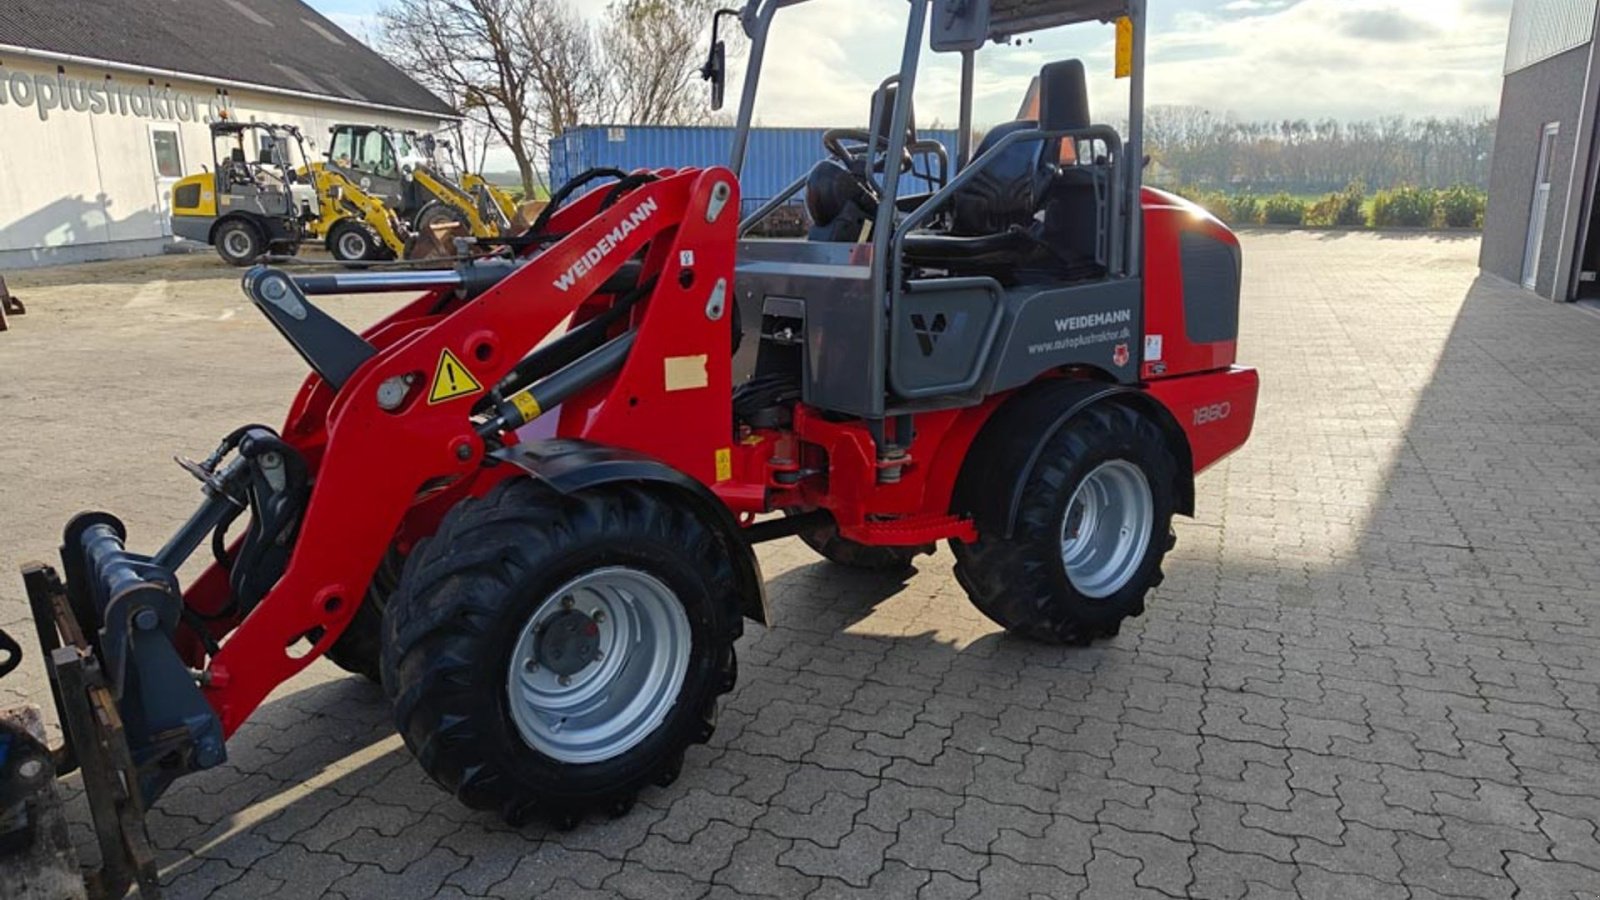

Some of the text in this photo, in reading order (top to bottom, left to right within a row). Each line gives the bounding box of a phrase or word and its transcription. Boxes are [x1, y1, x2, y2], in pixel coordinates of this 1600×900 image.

[552, 196, 659, 292] WEIDEMANN
[1054, 308, 1131, 332] WEIDEMANN
[1028, 326, 1131, 355] www.autoplustraktor.dk
[1193, 401, 1231, 426] 1880
